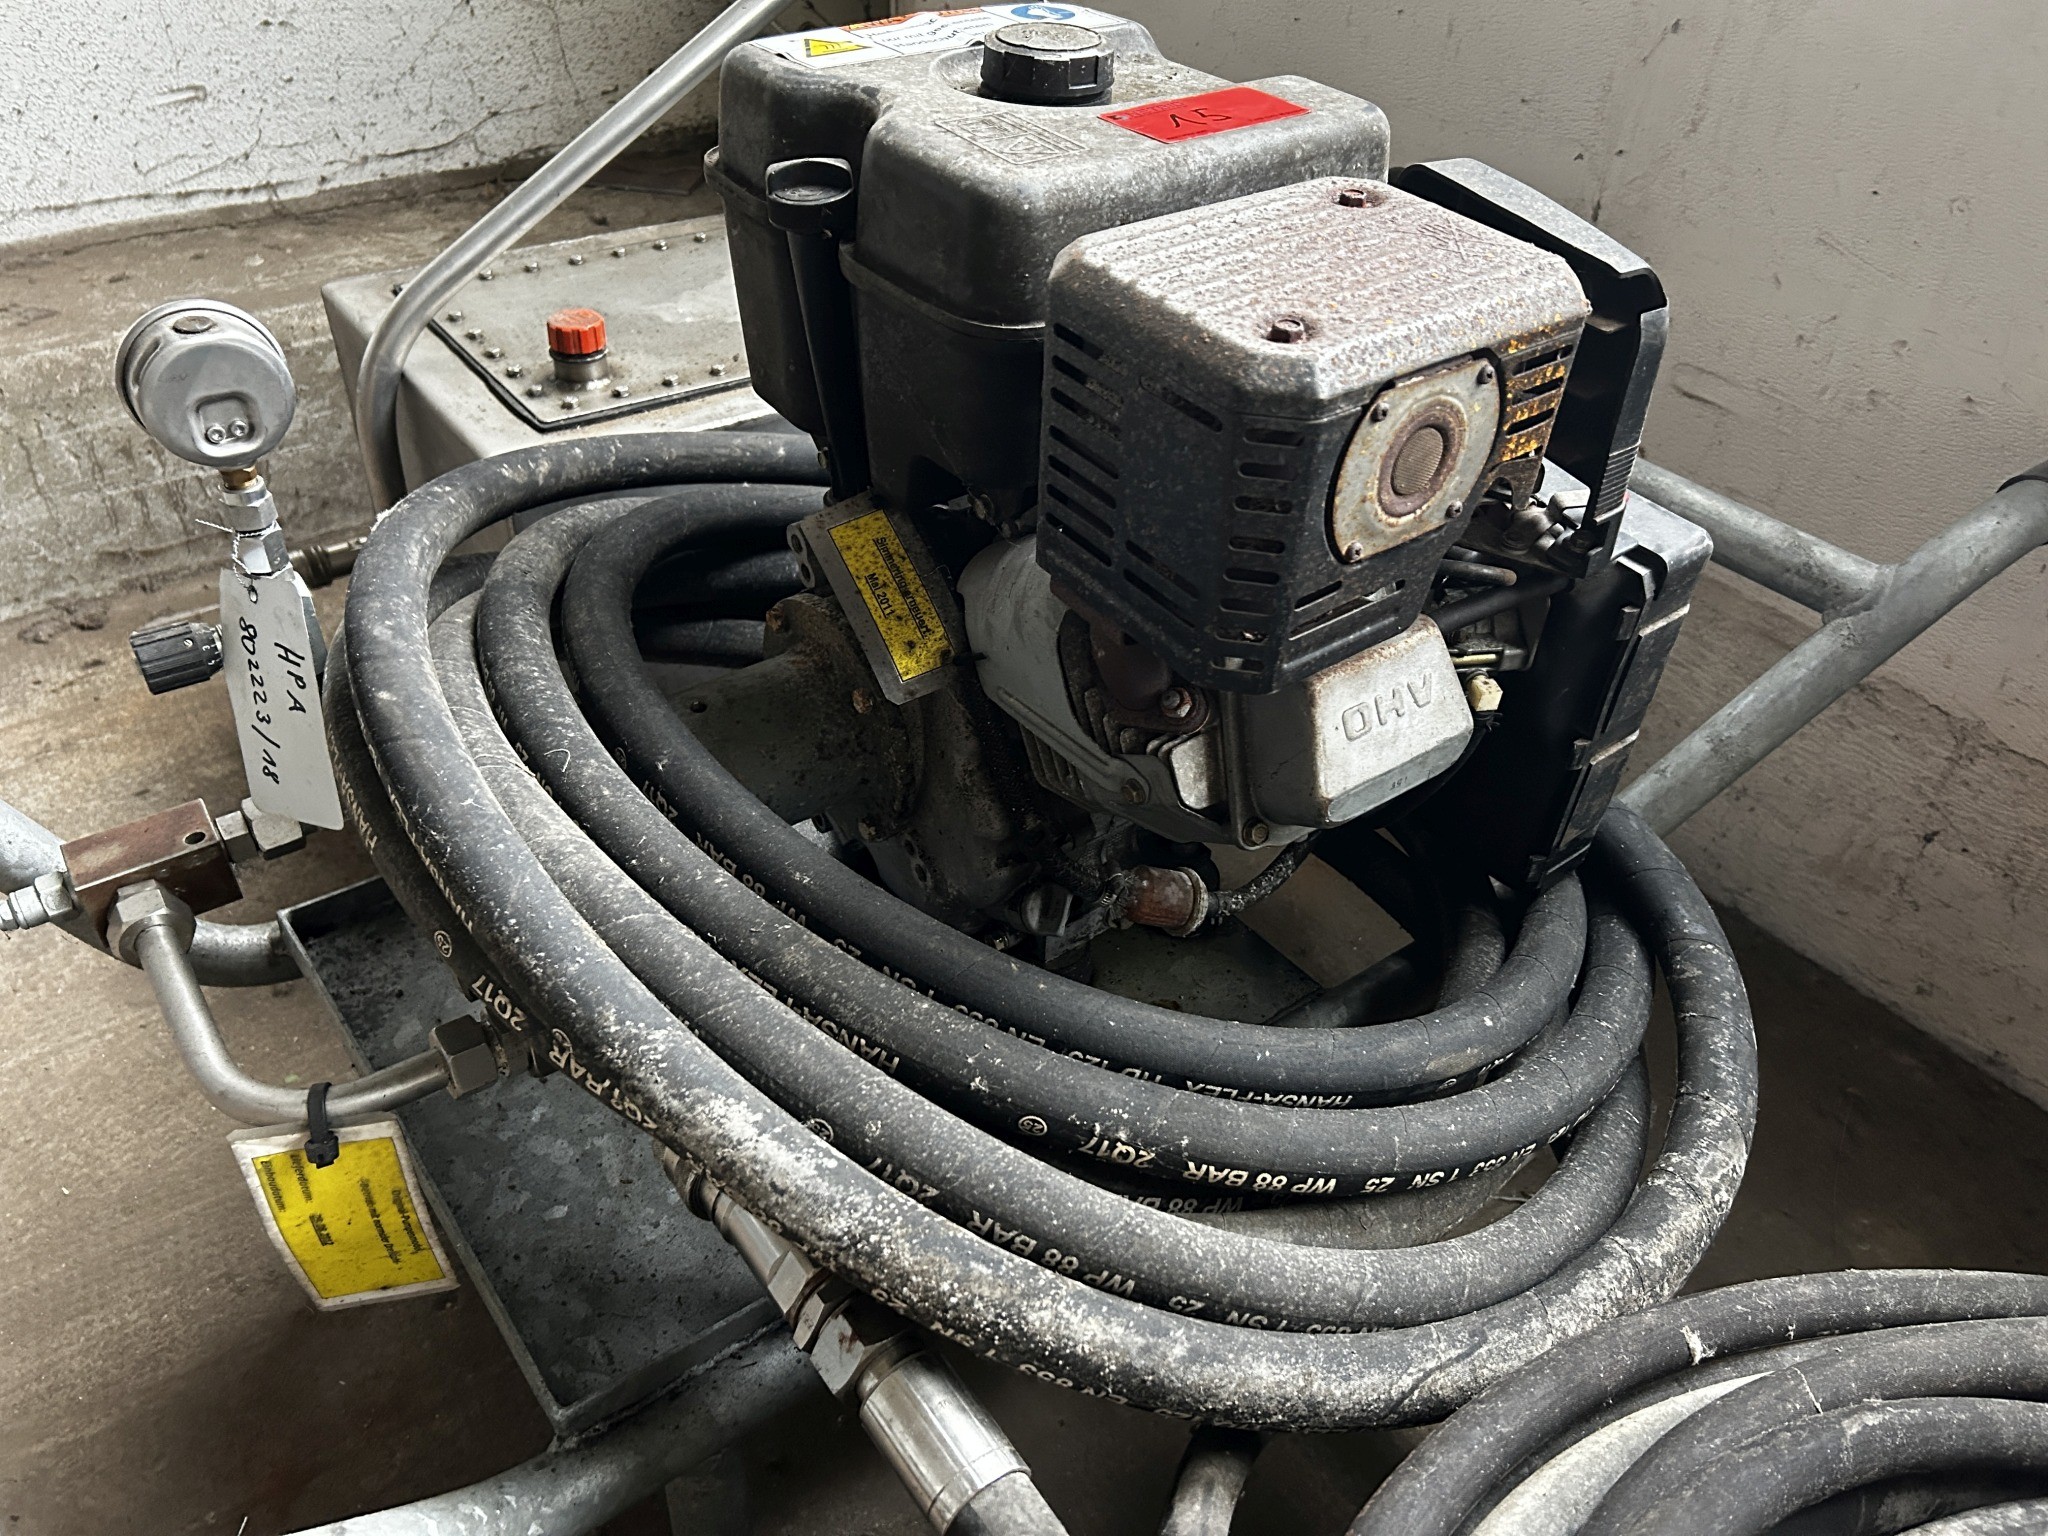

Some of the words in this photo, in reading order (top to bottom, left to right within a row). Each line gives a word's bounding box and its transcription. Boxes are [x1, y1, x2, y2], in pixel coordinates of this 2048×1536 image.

[1168, 107, 1233, 129] 15
[273, 641, 307, 714] HPA
[239, 616, 281, 785] 802223/18
[1341, 671, 1433, 743] OHV
[470, 974, 528, 1033] 2Q17
[1185, 1079, 1353, 1107] HANSA-FLEX
[1076, 1135, 1157, 1169] 2Q17
[259, 1159, 287, 1213] Einbaudatum:
[1182, 1160, 1249, 1188] BAR
[1251, 1172, 1289, 1192] 88
[1291, 1176, 1338, 1195] WP
[1359, 1176, 1396, 1194] 25
[1406, 1170, 1445, 1190] SN
[964, 1208, 1039, 1257] BAR
[1038, 1246, 1080, 1275] 88
[1082, 1268, 1137, 1298] WP
